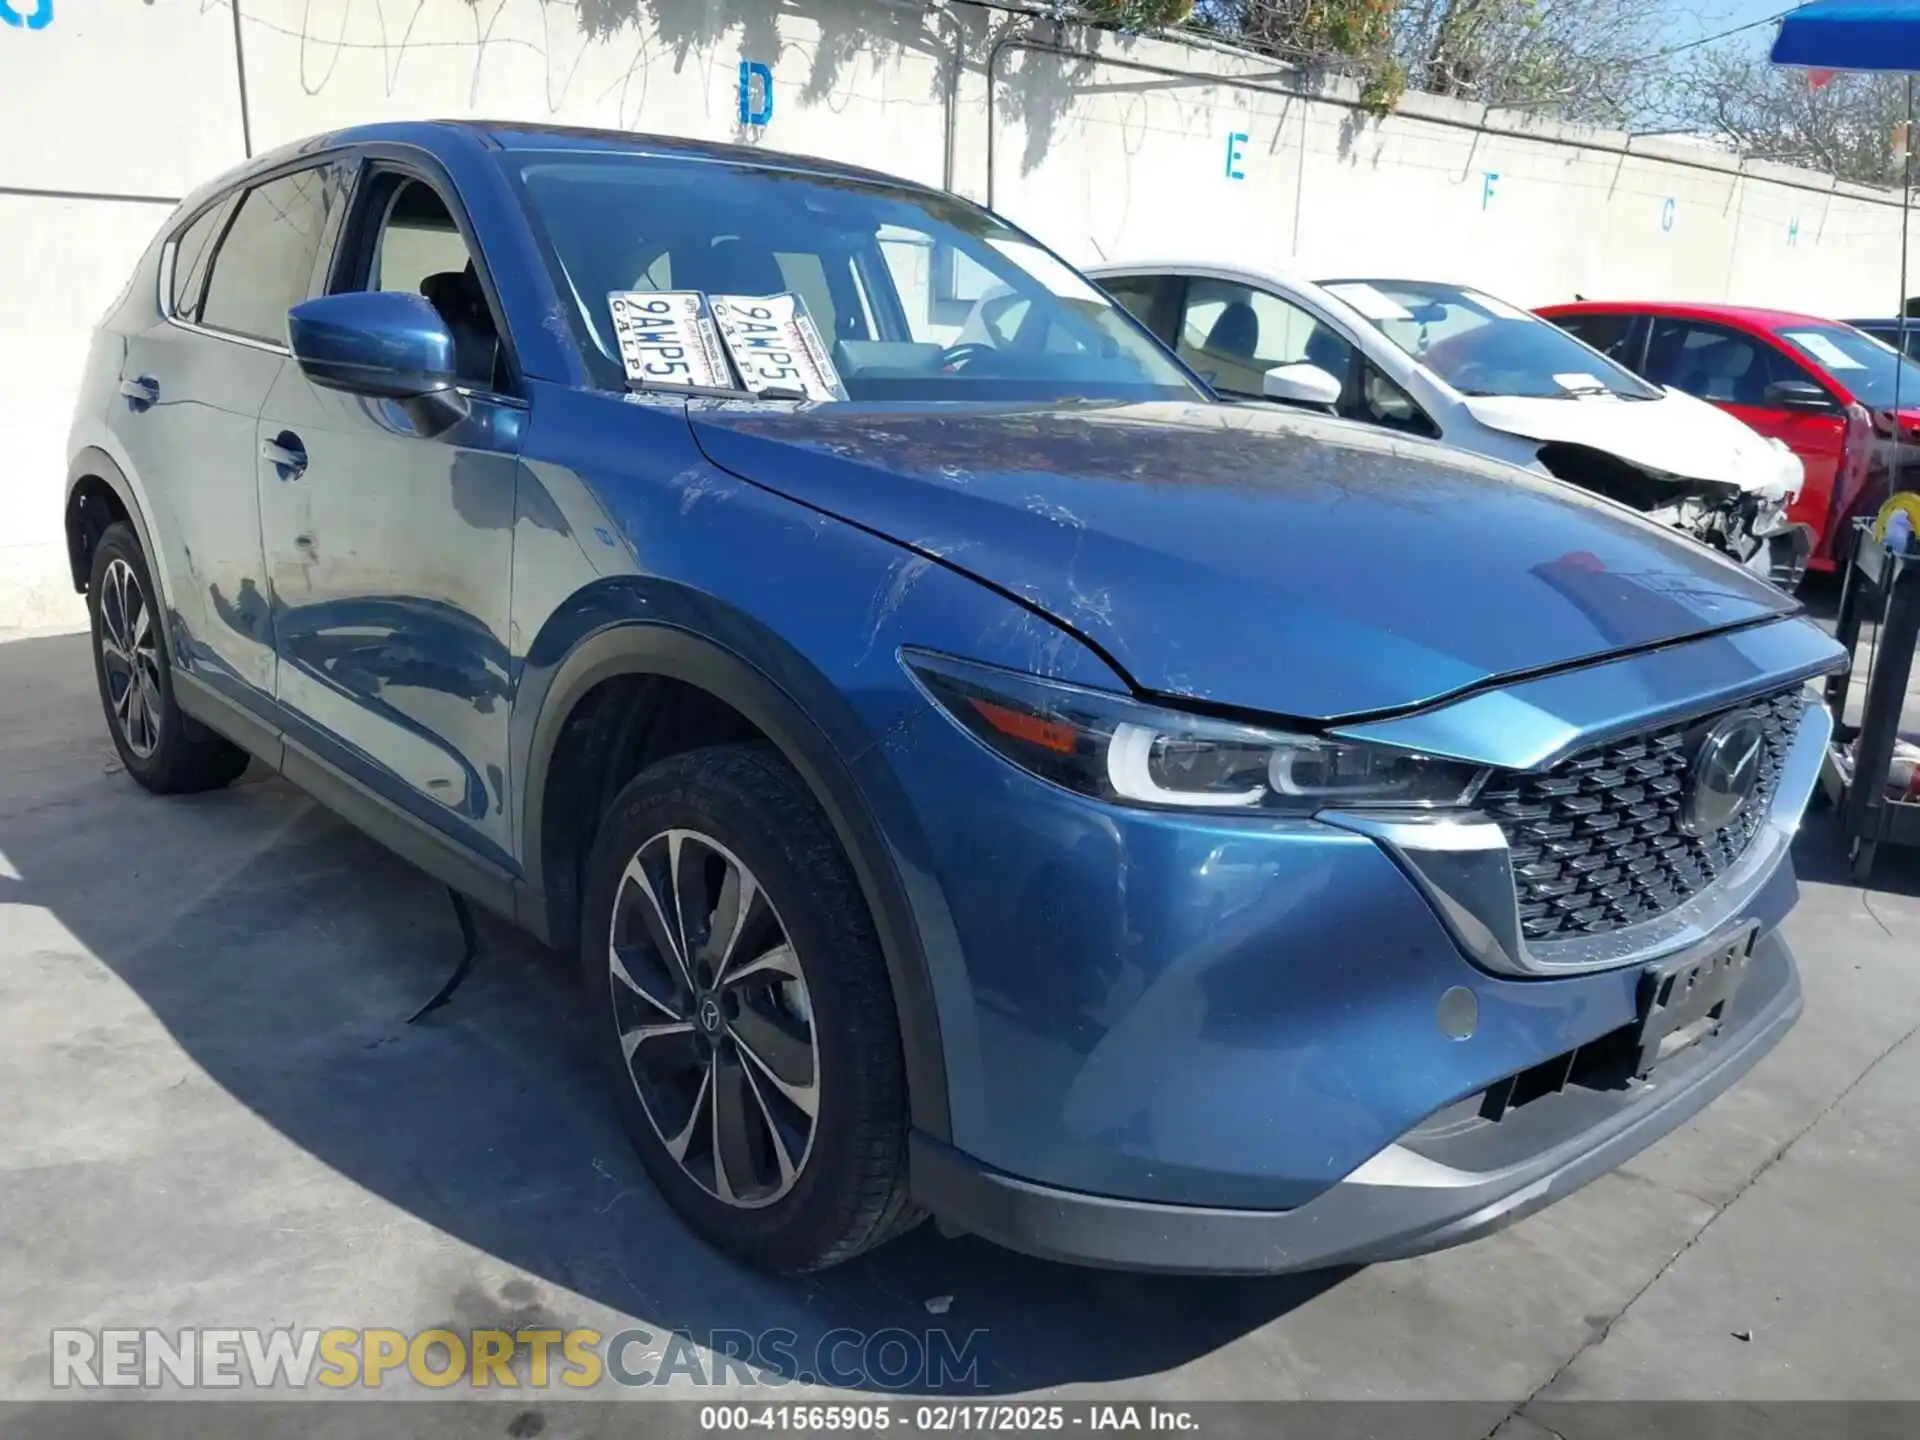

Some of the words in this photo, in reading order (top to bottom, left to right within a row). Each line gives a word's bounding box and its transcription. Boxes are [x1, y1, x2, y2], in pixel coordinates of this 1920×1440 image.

[739, 60, 773, 125] D
[1226, 132, 1249, 180] E
[1482, 173, 1499, 212] F
[1787, 217, 1800, 247] H
[626, 300, 694, 386] 9AWP5
